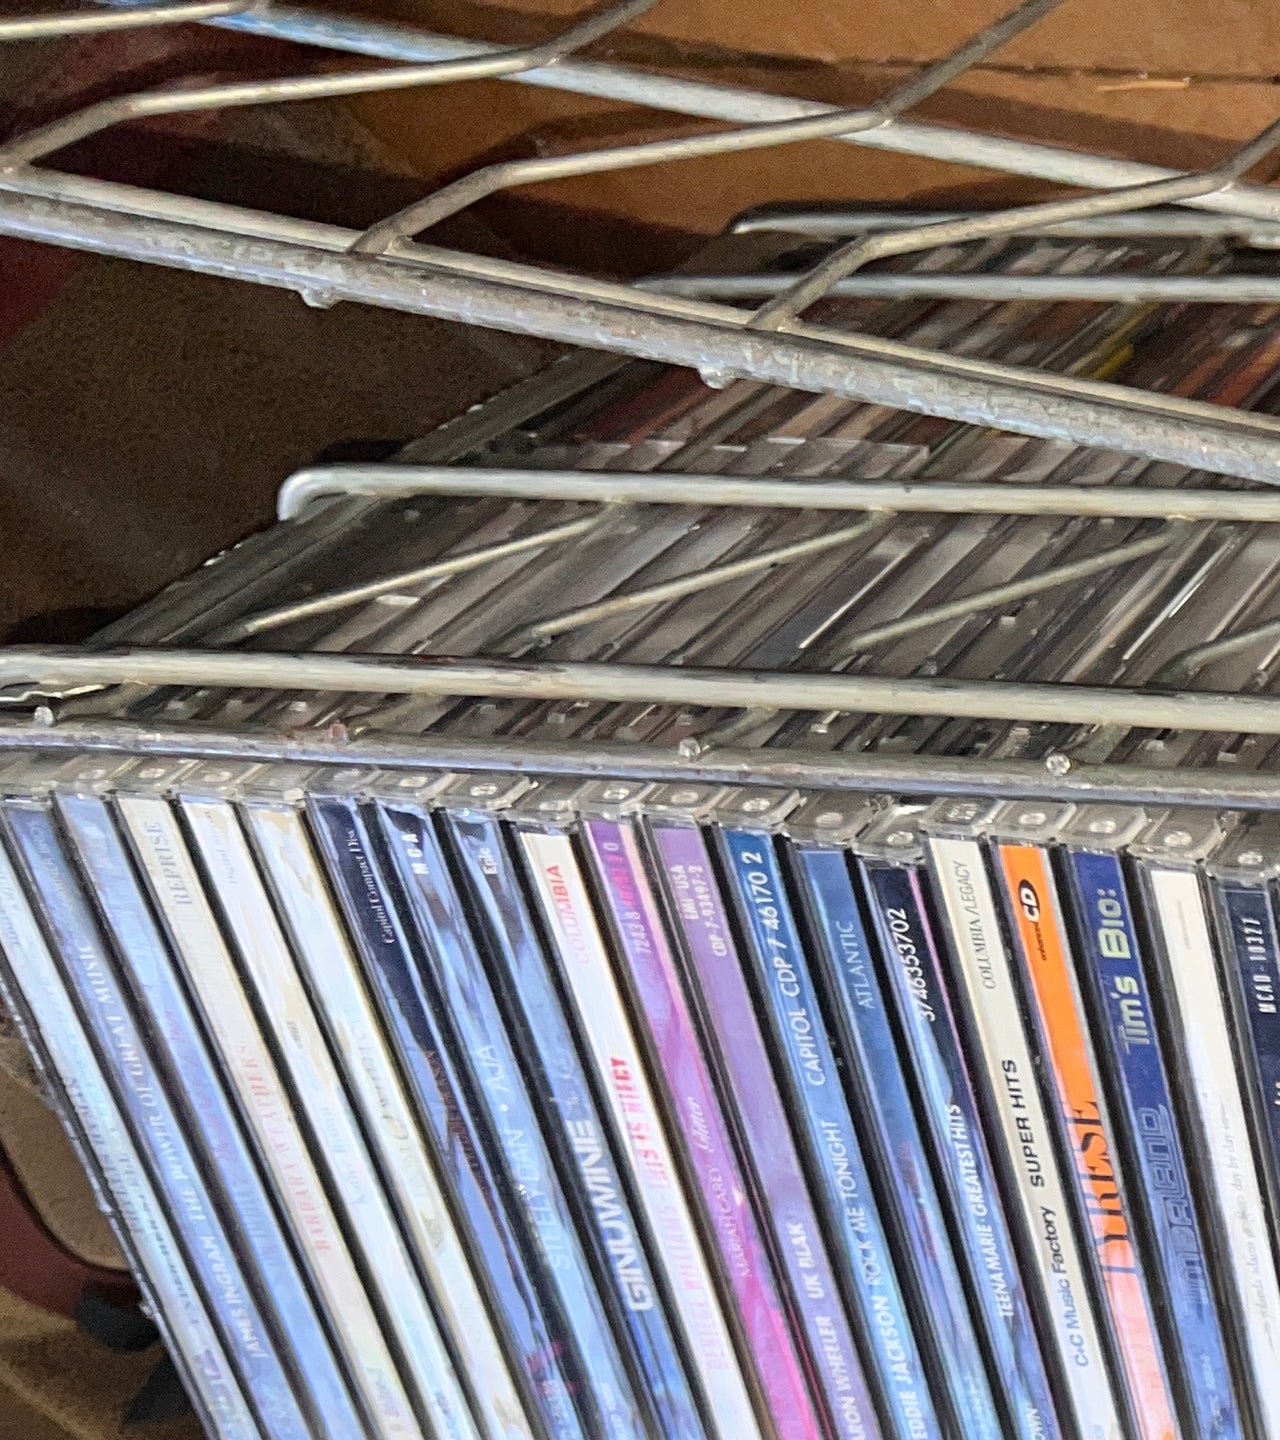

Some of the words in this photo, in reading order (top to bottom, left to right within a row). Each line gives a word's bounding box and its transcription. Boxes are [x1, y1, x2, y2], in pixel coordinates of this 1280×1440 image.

[475, 846, 499, 874] Epic
[544, 863, 592, 963] COLUMBIA
[834, 919, 877, 1008] ATLANTIC
[1000, 1058, 1027, 1109] HITS
[942, 1102, 969, 1140] HITS
[819, 1119, 860, 1198] TONIGHT
[1014, 1115, 1046, 1188] SUPER
[952, 1140, 989, 1216] GREATEST
[563, 1118, 656, 1311] GINUWINE
[845, 1206, 870, 1233] ME
[787, 1220, 816, 1267] BLAK
[855, 1240, 885, 1286] ROCK
[974, 1222, 1004, 1271] MARIE
[803, 1274, 825, 1298] UK
[987, 1272, 1015, 1317] TEENA
[815, 1315, 853, 1391] WHEELER
[871, 1296, 913, 1384] JACKSON
